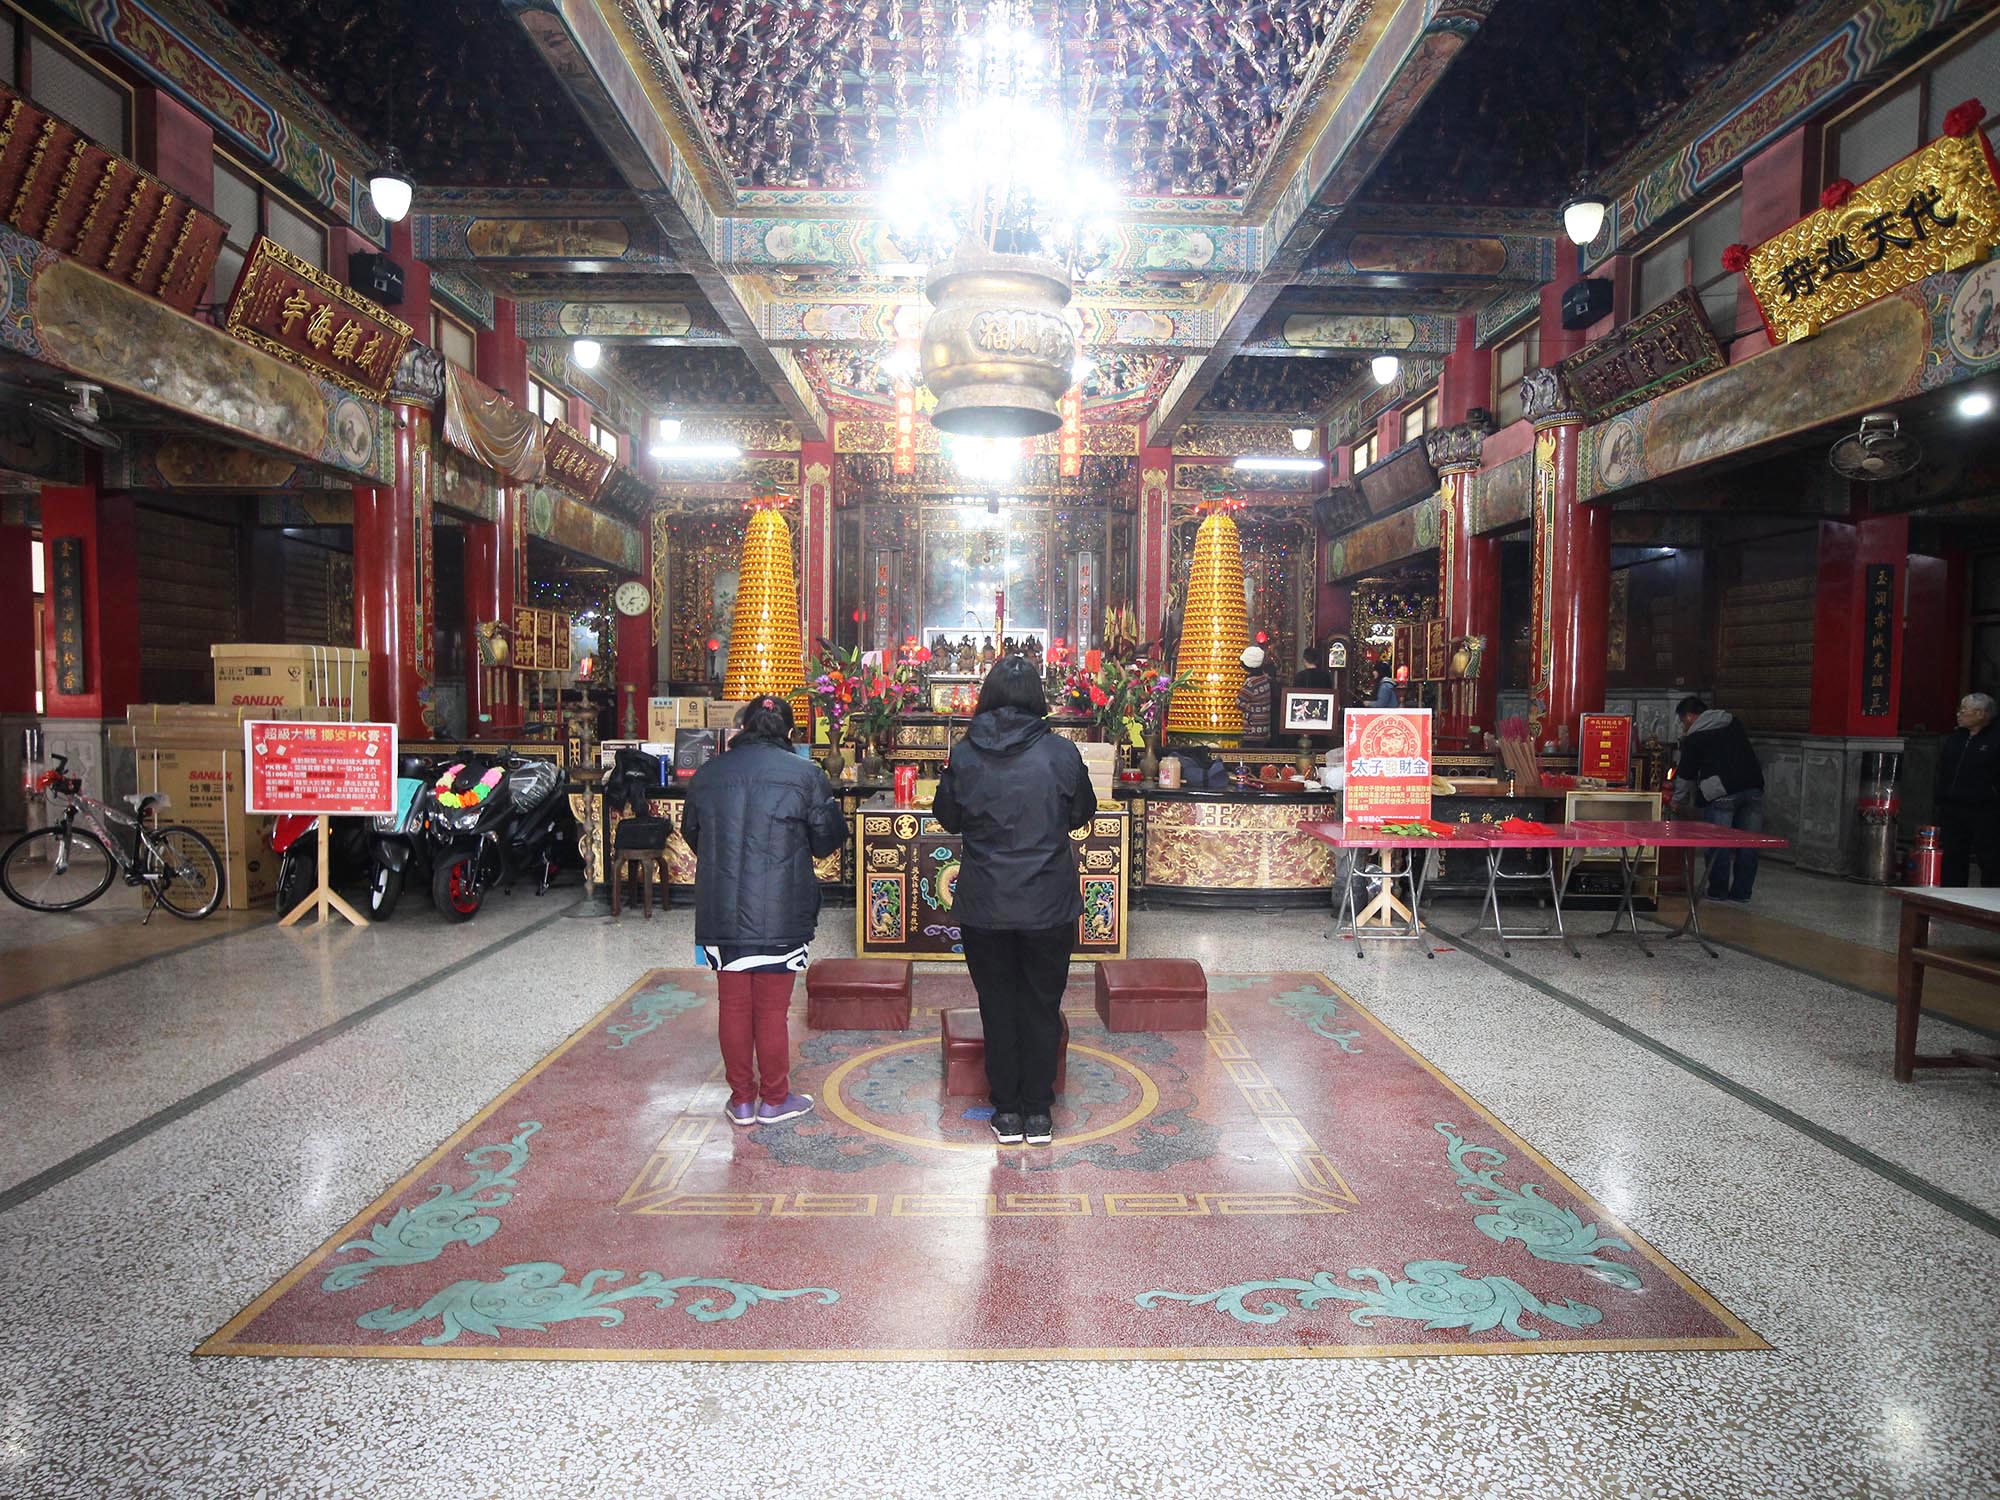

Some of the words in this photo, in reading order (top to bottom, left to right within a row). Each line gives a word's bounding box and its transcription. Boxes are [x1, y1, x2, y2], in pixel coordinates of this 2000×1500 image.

[1778, 184, 1959, 304] 代天巡狩
[231, 695, 285, 707] SANLUX
[1352, 758, 1428, 775] 太子發財金
[188, 770, 233, 781] SANLUX
